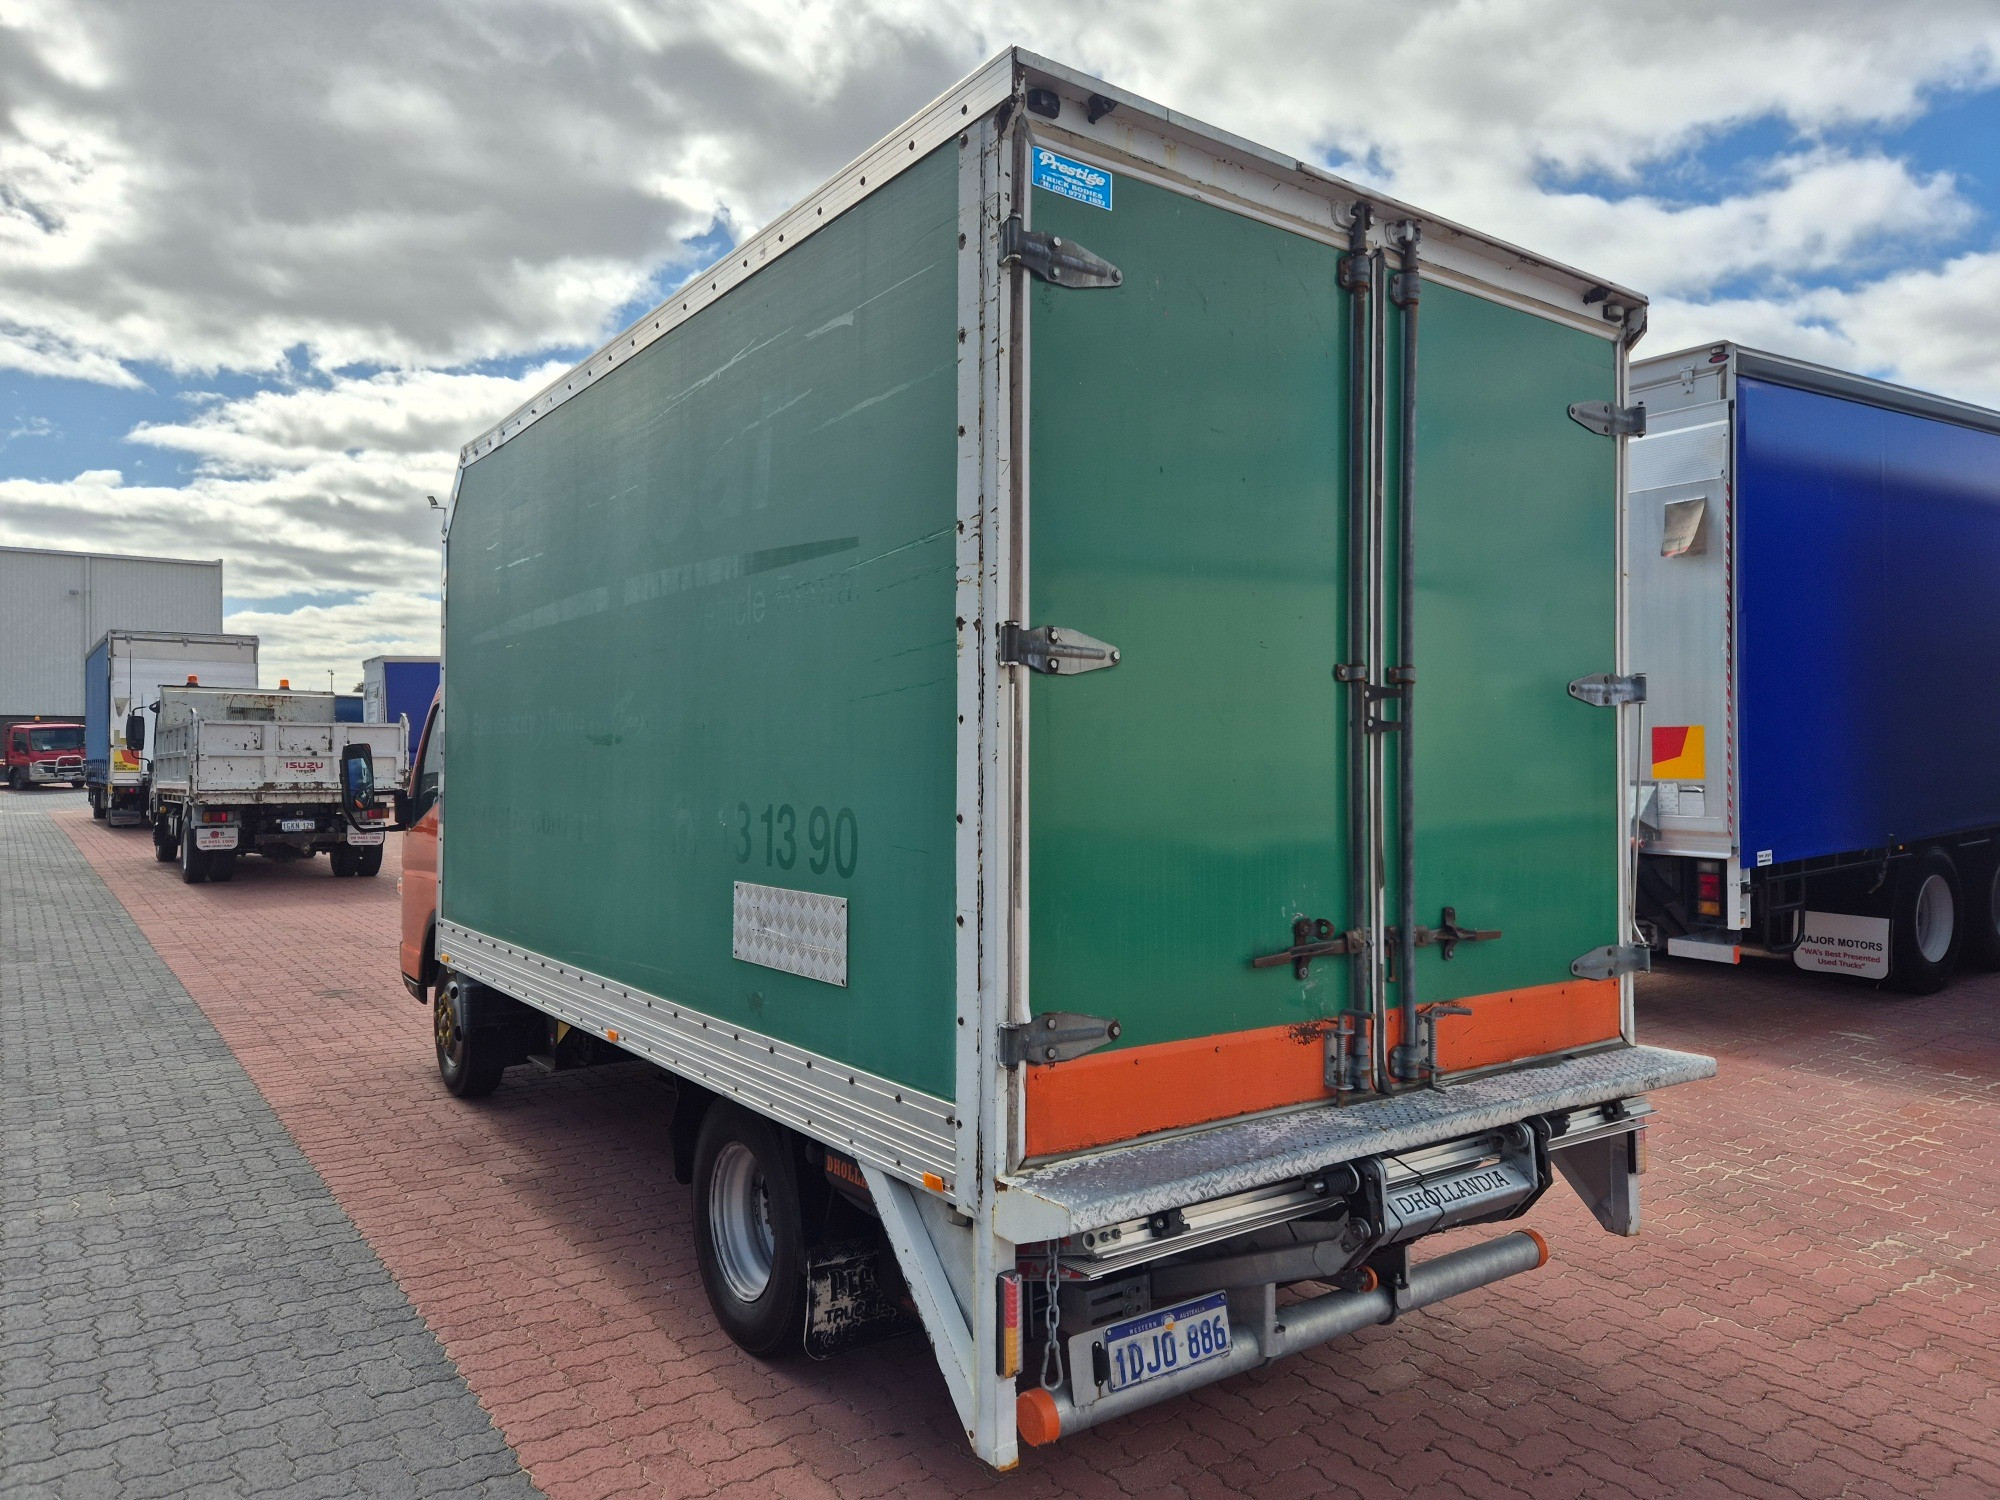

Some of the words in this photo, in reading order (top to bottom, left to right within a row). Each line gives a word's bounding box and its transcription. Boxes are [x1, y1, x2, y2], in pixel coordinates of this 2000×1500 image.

[1039, 151, 1106, 186] Prestige
[1041, 174, 1070, 188] TRUCK
[1071, 184, 1103, 200] BODIES
[285, 761, 324, 769] ISUZU
[1824, 949, 1842, 959] Best
[1843, 951, 1881, 964] Presented
[1837, 938, 1883, 952] MOTORS
[1817, 958, 1837, 967] Used
[1395, 1170, 1511, 1215] DHOLLANDIA
[1129, 1320, 1158, 1335] WESTERN
[1179, 1306, 1206, 1320] AUSTRALIA
[1187, 1314, 1228, 1359] 886
